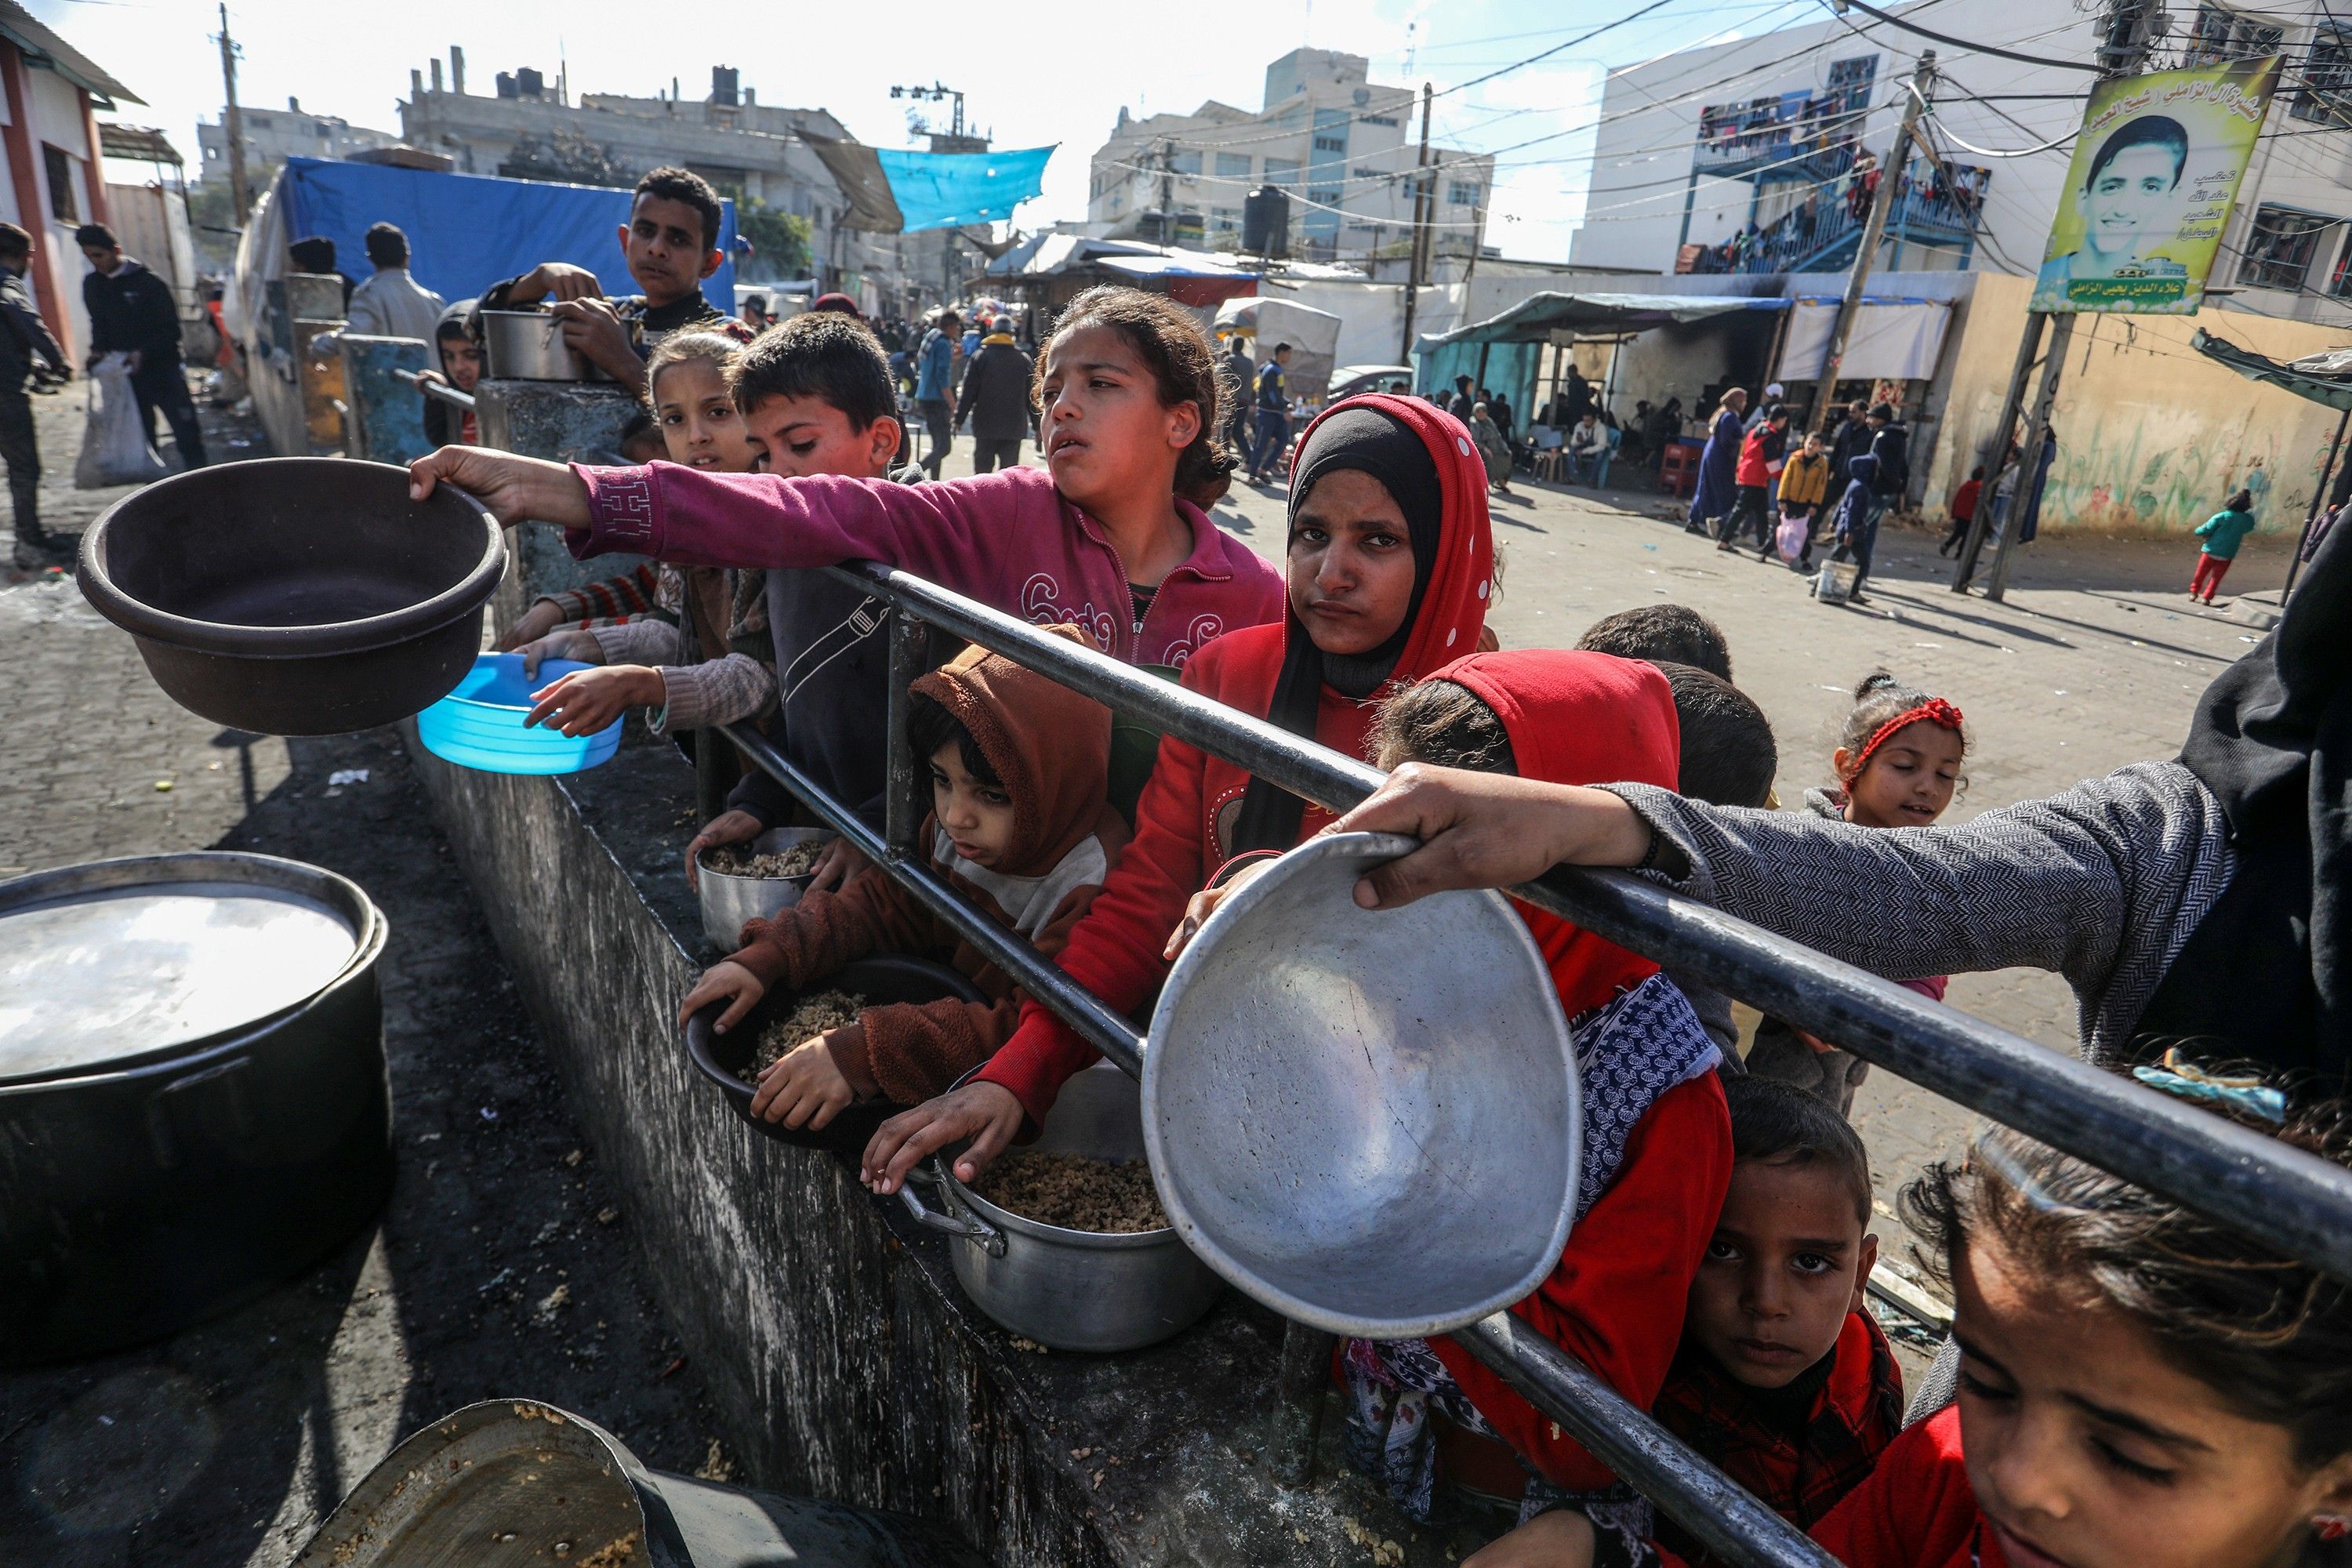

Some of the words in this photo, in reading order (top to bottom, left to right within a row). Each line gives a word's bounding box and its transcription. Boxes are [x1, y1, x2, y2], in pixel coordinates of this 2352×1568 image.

[2163, 81, 2215, 107] الزاملي
[2227, 86, 2261, 122] عشيرة
[2188, 189, 2208, 202] الله
[2208, 190, 2228, 201] عند
[2182, 208, 2224, 224] الشهيد
[2069, 281, 2103, 299] الزاملي
[2129, 282, 2158, 297] الدين
[2158, 281, 2180, 293] علاء
